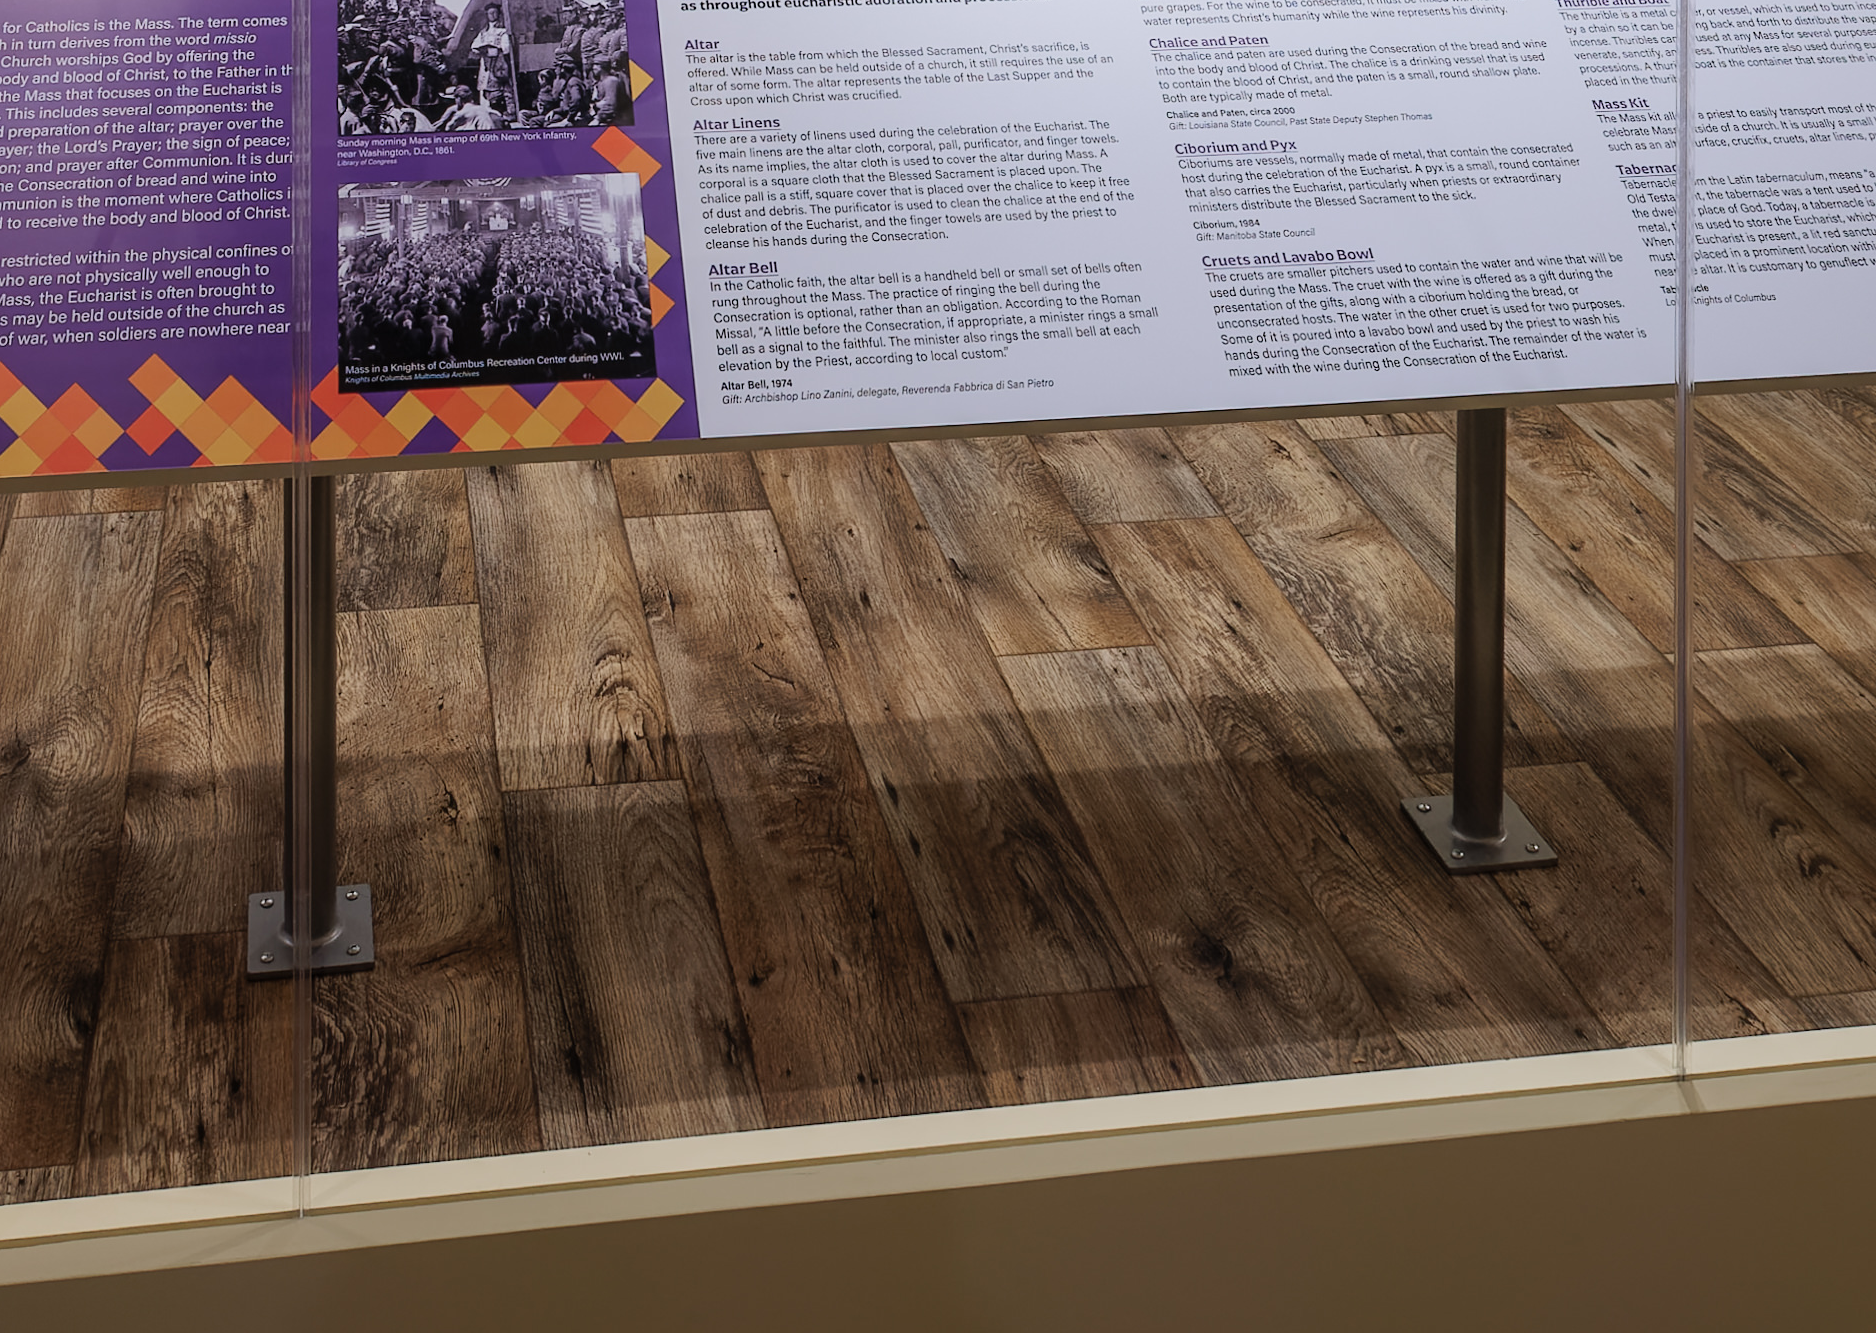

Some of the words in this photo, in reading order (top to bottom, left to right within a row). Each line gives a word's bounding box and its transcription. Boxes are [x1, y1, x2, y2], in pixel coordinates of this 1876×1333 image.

[2, 21, 21, 34] for
[25, 19, 89, 33] Catholics
[93, 19, 105, 32] is
[108, 18, 130, 31] the
[134, 17, 174, 31] Mass.
[176, 16, 204, 29] The
[206, 16, 238, 29] term
[242, 17, 287, 28] comes
[685, 38, 720, 50] Altar
[1149, 37, 1198, 49] Chalice
[1201, 36, 1226, 47] and
[1229, 35, 1268, 46] Paten
[1592, 98, 1627, 109] Mass
[1629, 97, 1649, 108] Kit
[693, 118, 729, 131] Altar
[732, 117, 780, 130] Linens
[1174, 141, 1239, 154] Ciborium
[1242, 140, 1268, 152] and
[1270, 139, 1297, 153] Pyx
[1193, 219, 1237, 230] Ciborium,
[1239, 218, 1260, 227] 1984
[1202, 253, 1251, 267] Cruets
[1253, 252, 1280, 265] and
[1282, 249, 1334, 263] Lavabo
[1337, 247, 1373, 261] Bowl
[709, 263, 745, 276] Altar
[749, 261, 778, 274] Bell
[345, 364, 369, 374] Mass
[371, 363, 380, 373] in
[390, 361, 425, 374] Knights
[427, 361, 436, 370] of
[438, 358, 484, 370] Columbus
[486, 356, 534, 367] Recreation
[536, 355, 566, 365] Center
[568, 353, 598, 366] during
[721, 381, 744, 390] Altar
[747, 380, 768, 390] Bell,
[771, 379, 792, 388] 1974
